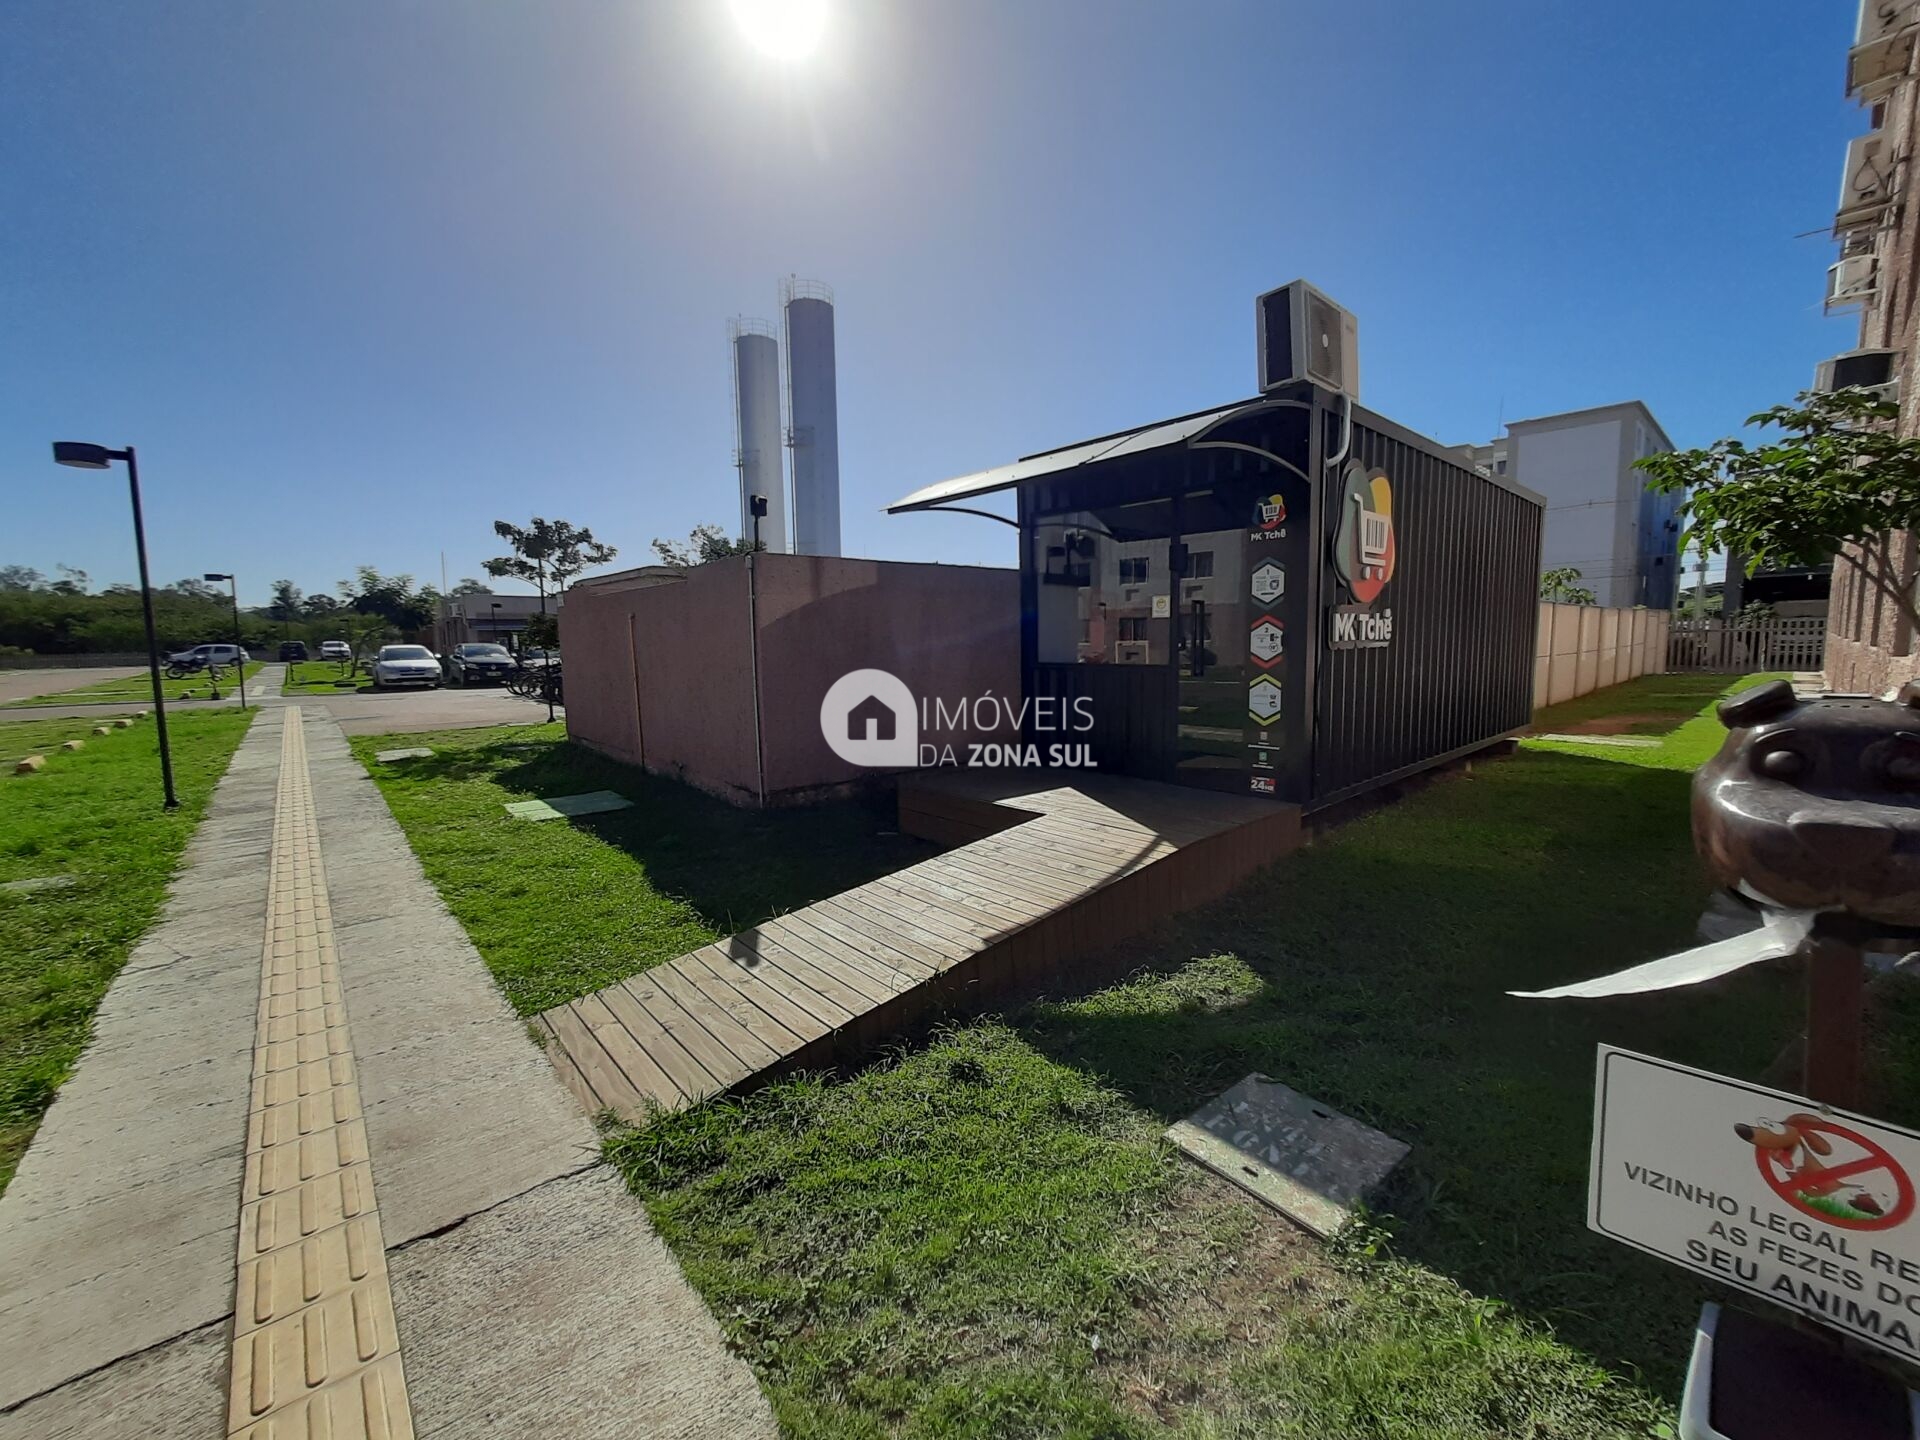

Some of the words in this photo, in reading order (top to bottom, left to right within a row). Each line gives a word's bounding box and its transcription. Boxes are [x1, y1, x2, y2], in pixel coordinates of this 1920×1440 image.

[1333, 613, 1356, 642] MK
[1623, 1161, 1739, 1216] VIZINHO
[1750, 1205, 1858, 1261] LEGAL
[1870, 1248, 1920, 1285] RE
[1707, 1220, 1748, 1247] AS
[1758, 1237, 1864, 1292] FEZES
[1686, 1238, 1758, 1282] SEU
[1771, 1273, 1920, 1351] ANIMA
